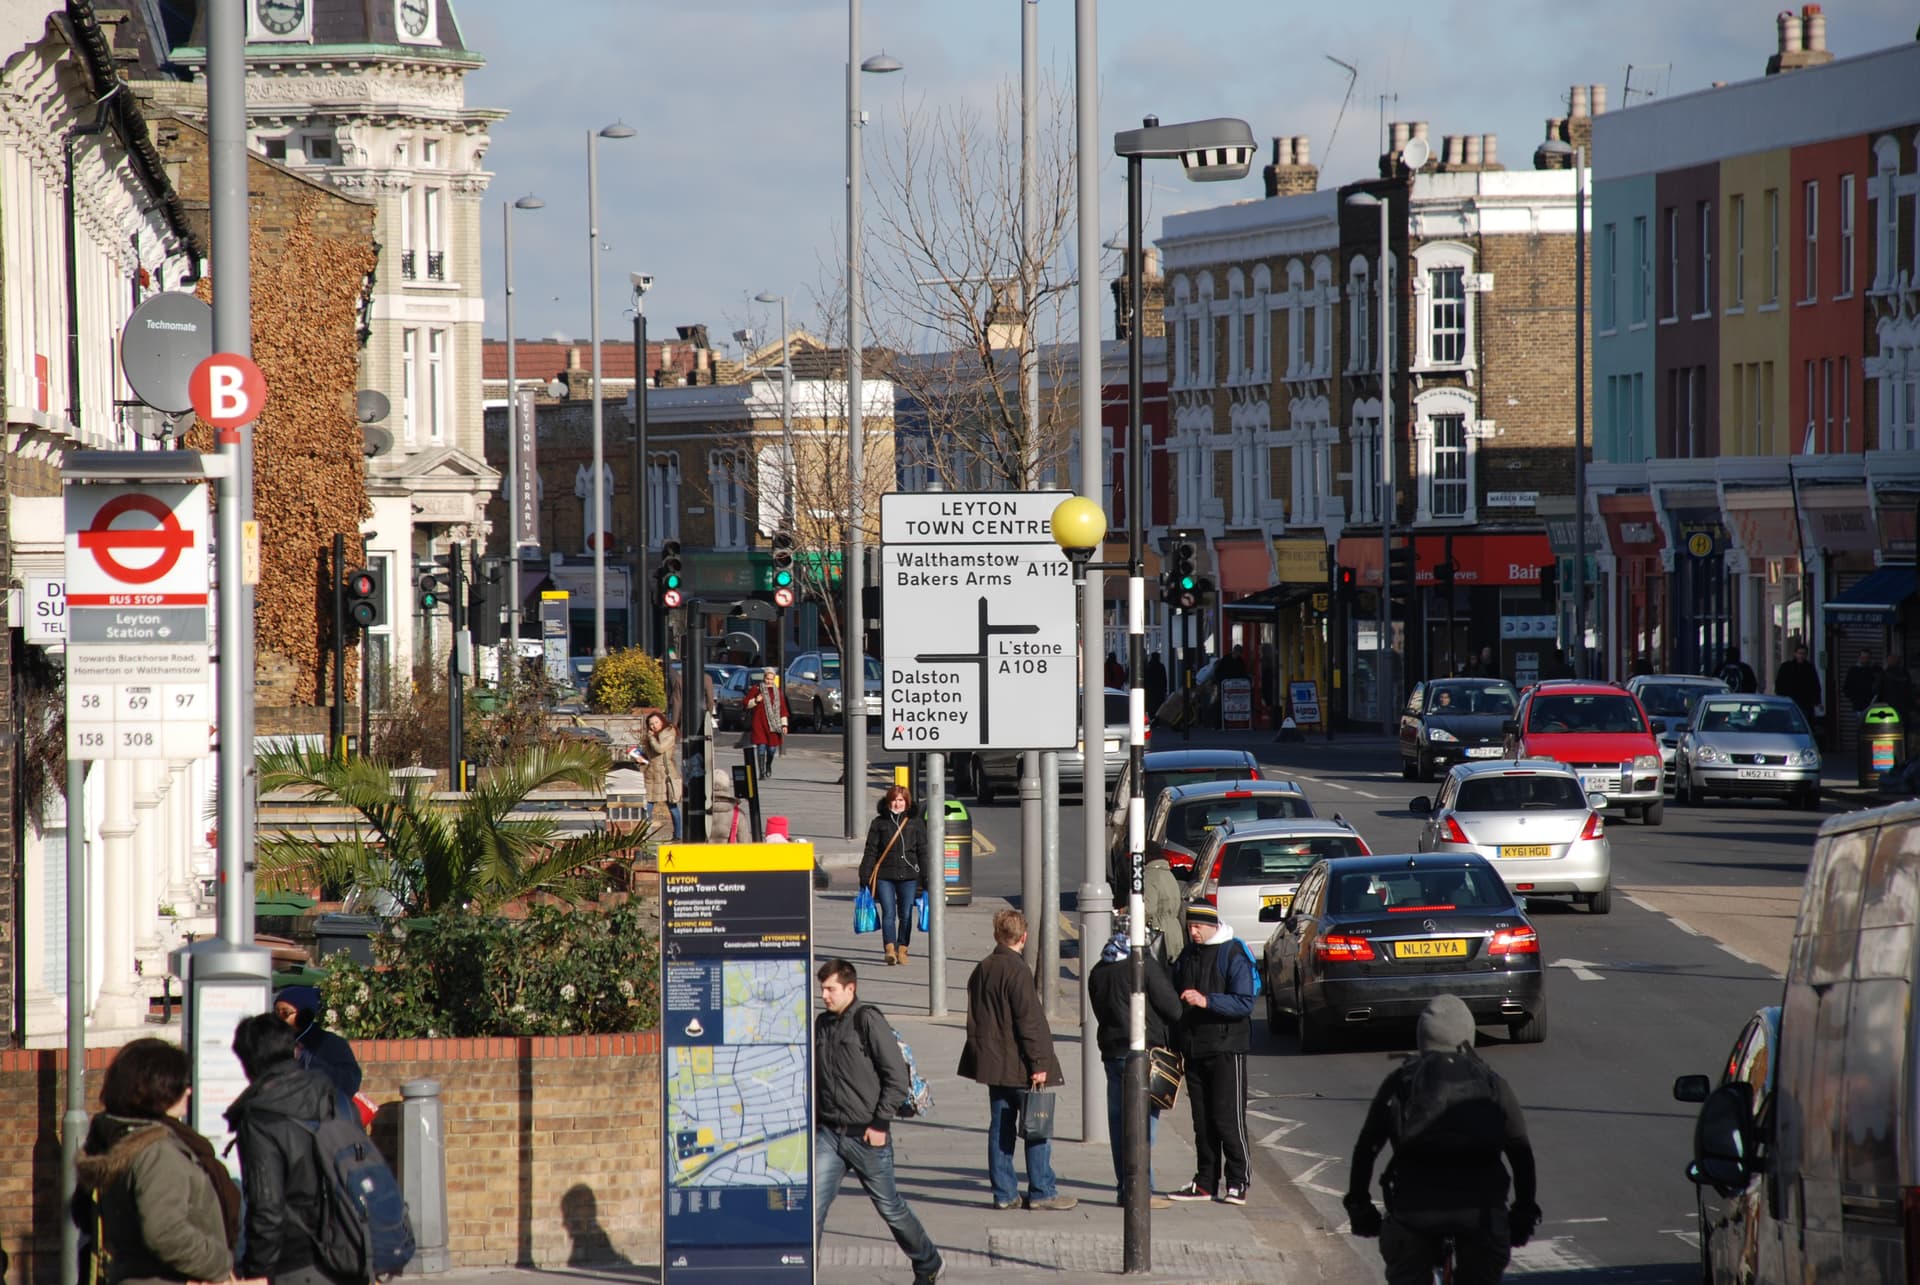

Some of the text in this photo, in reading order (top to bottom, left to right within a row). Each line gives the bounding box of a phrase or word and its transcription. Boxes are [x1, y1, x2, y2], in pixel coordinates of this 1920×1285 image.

[146, 319, 197, 332] Technomate
[210, 365, 249, 418] B
[522, 393, 532, 530] LEYTON LIBRARY
[942, 501, 1017, 516] LEYTON
[906, 520, 1051, 535] TOWN CENTRE
[897, 552, 1019, 567] Walthamstow
[897, 571, 1012, 586] Bakers Arms
[109, 595, 164, 605] BUS STOP
[116, 613, 160, 626] Leyton
[106, 627, 154, 638] Station
[999, 641, 1062, 655] L'stone
[79, 655, 116, 663] towards
[119, 654, 168, 662] Blackhorse
[74, 667, 121, 675] Homerton
[136, 666, 200, 674] Walthamstow
[999, 660, 1048, 674] A108
[892, 670, 960, 684] Dalston
[81, 694, 101, 708] 58
[129, 696, 148, 710] 69
[175, 694, 195, 707] 97
[891, 689, 962, 705] Clapton
[892, 708, 968, 724] Hackney
[79, 733, 104, 746] 158
[123, 733, 153, 746] 308
[891, 726, 940, 741] A106
[1504, 848, 1527, 856] KY61
[667, 876, 698, 885] LEYTON
[667, 883, 746, 894] Leyton Town Centre
[1403, 942, 1458, 954] NL12 VYA
